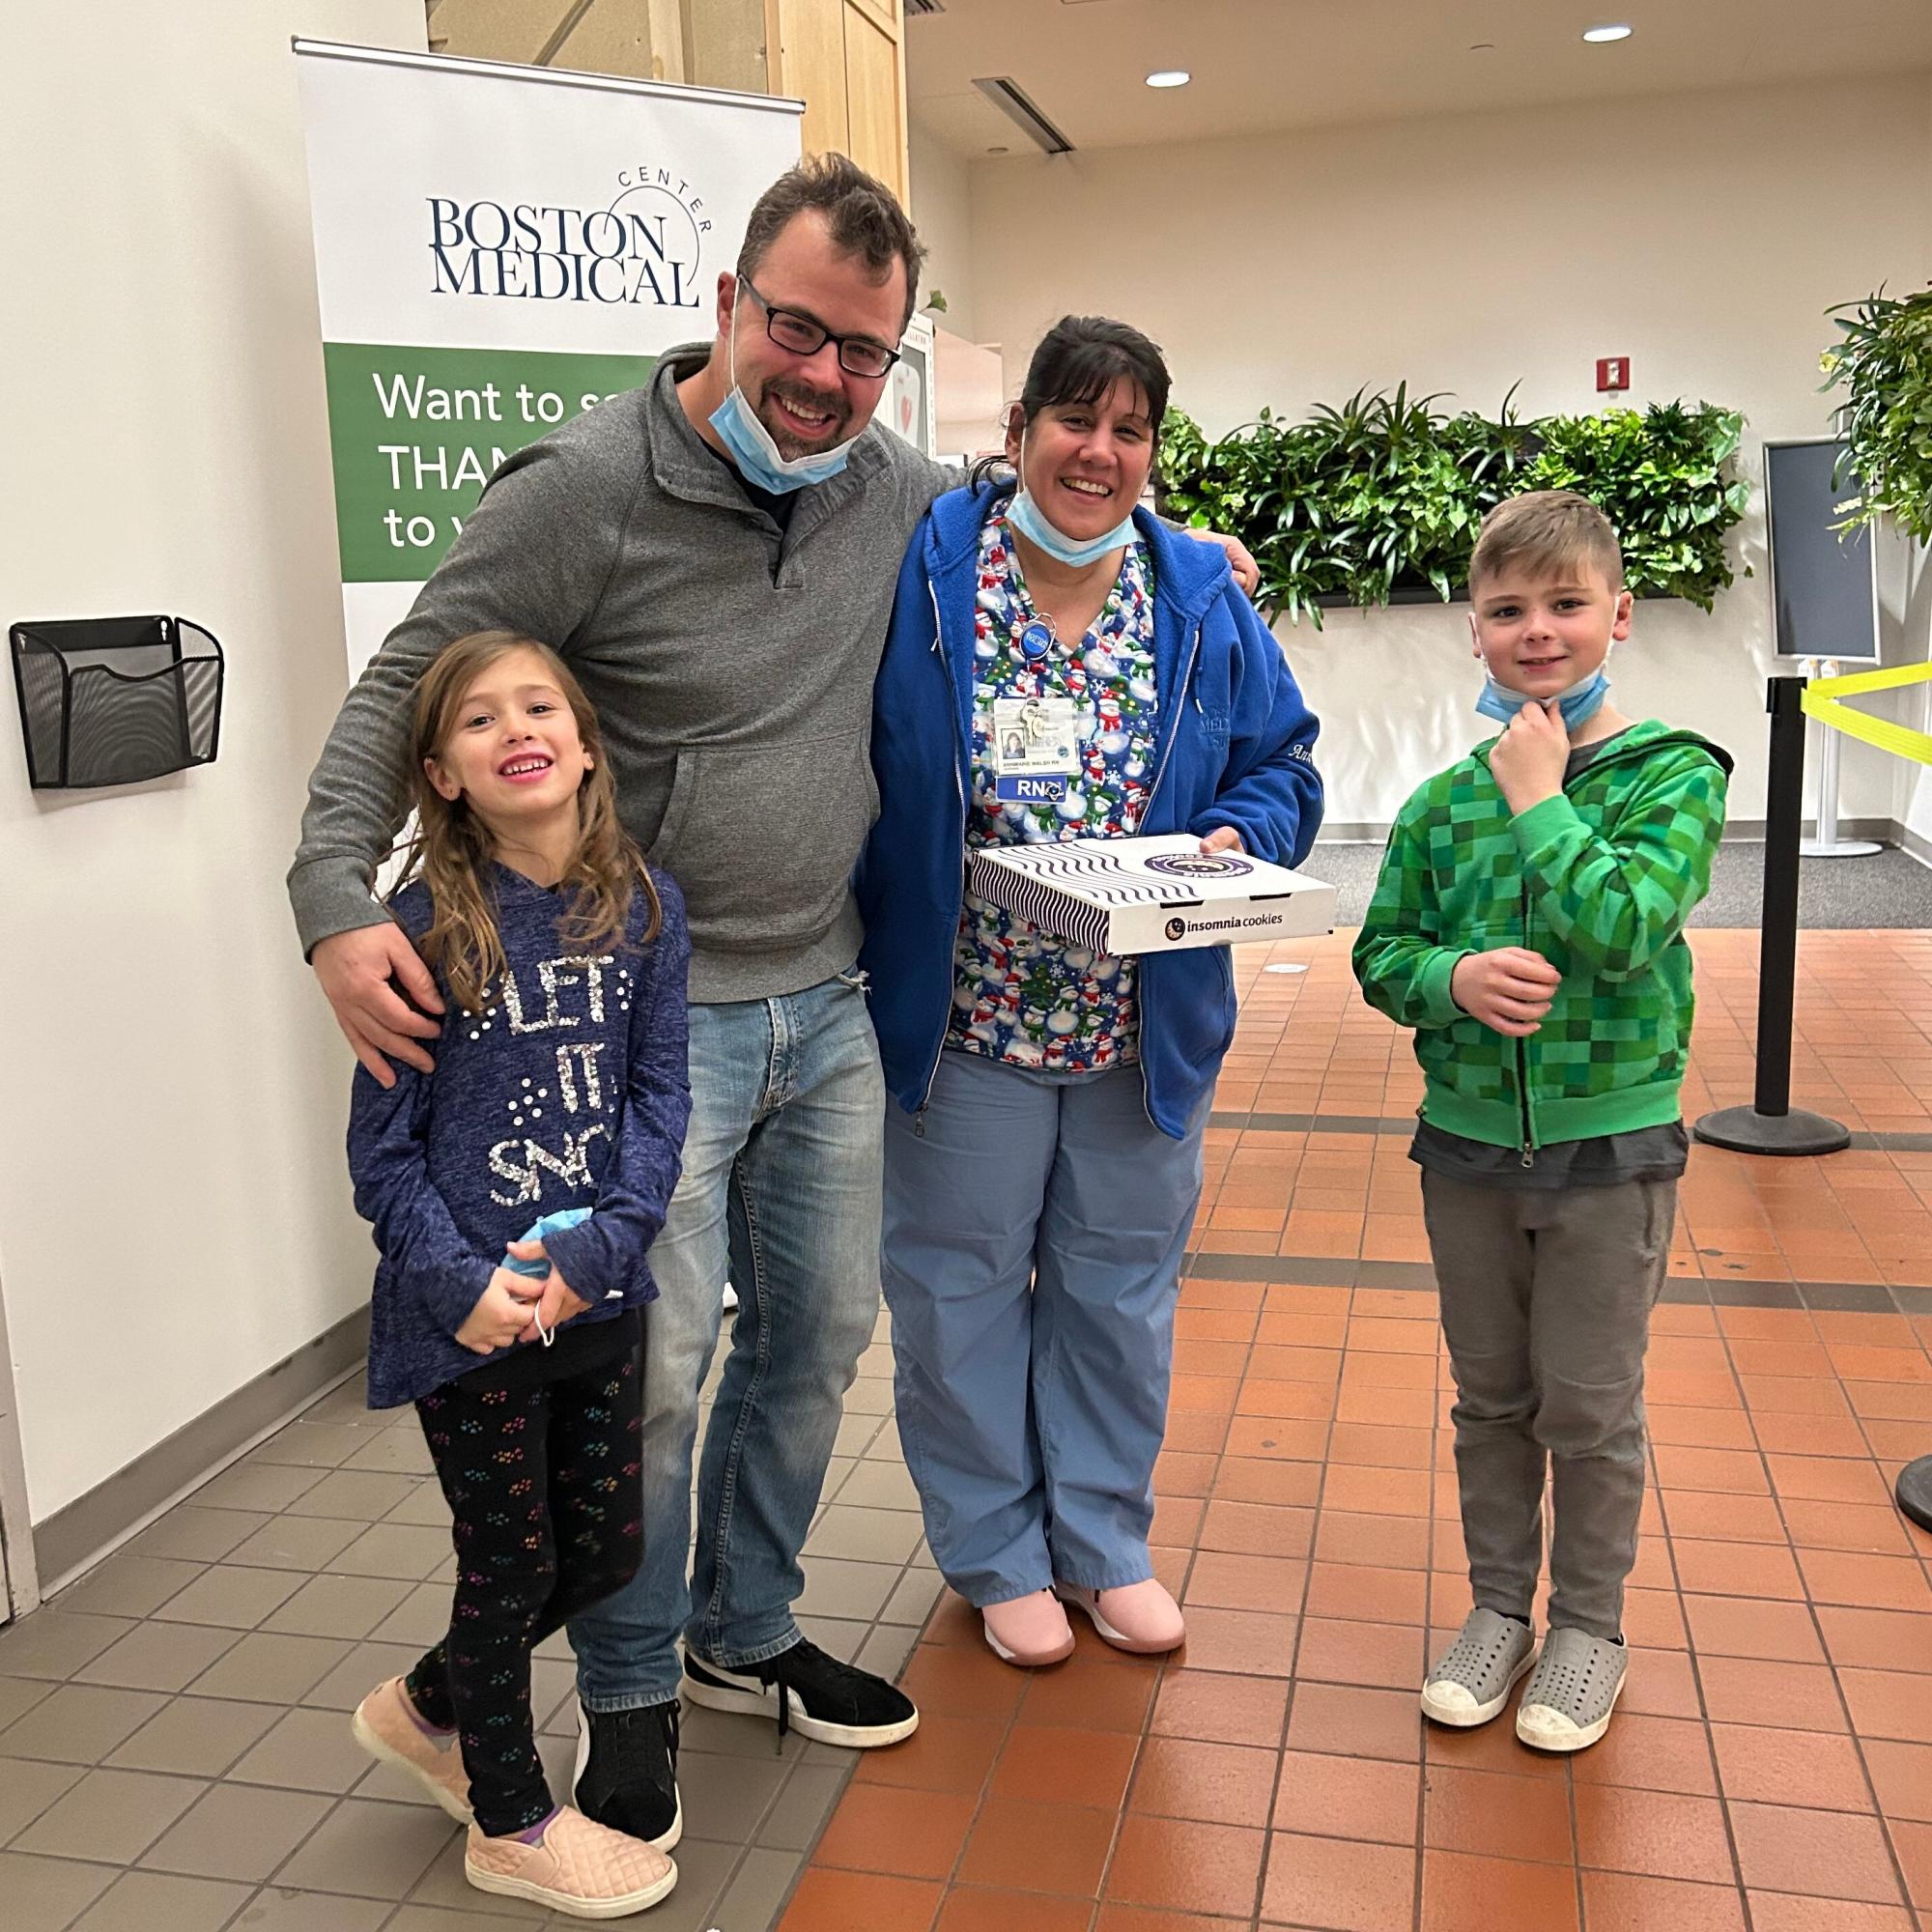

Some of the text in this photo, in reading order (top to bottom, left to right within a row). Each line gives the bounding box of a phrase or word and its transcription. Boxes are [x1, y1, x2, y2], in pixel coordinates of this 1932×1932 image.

[426, 197, 668, 263] BOSTON
[618, 166, 712, 233] CENTER
[429, 243, 699, 308] MEDICAL
[372, 373, 502, 421] Want
[516, 384, 564, 423] to
[384, 508, 436, 548] to
[1017, 780, 1045, 797] RN
[1187, 913, 1283, 932] insomnia cookies
[499, 954, 614, 1036] LET
[556, 1042, 606, 1114] IT
